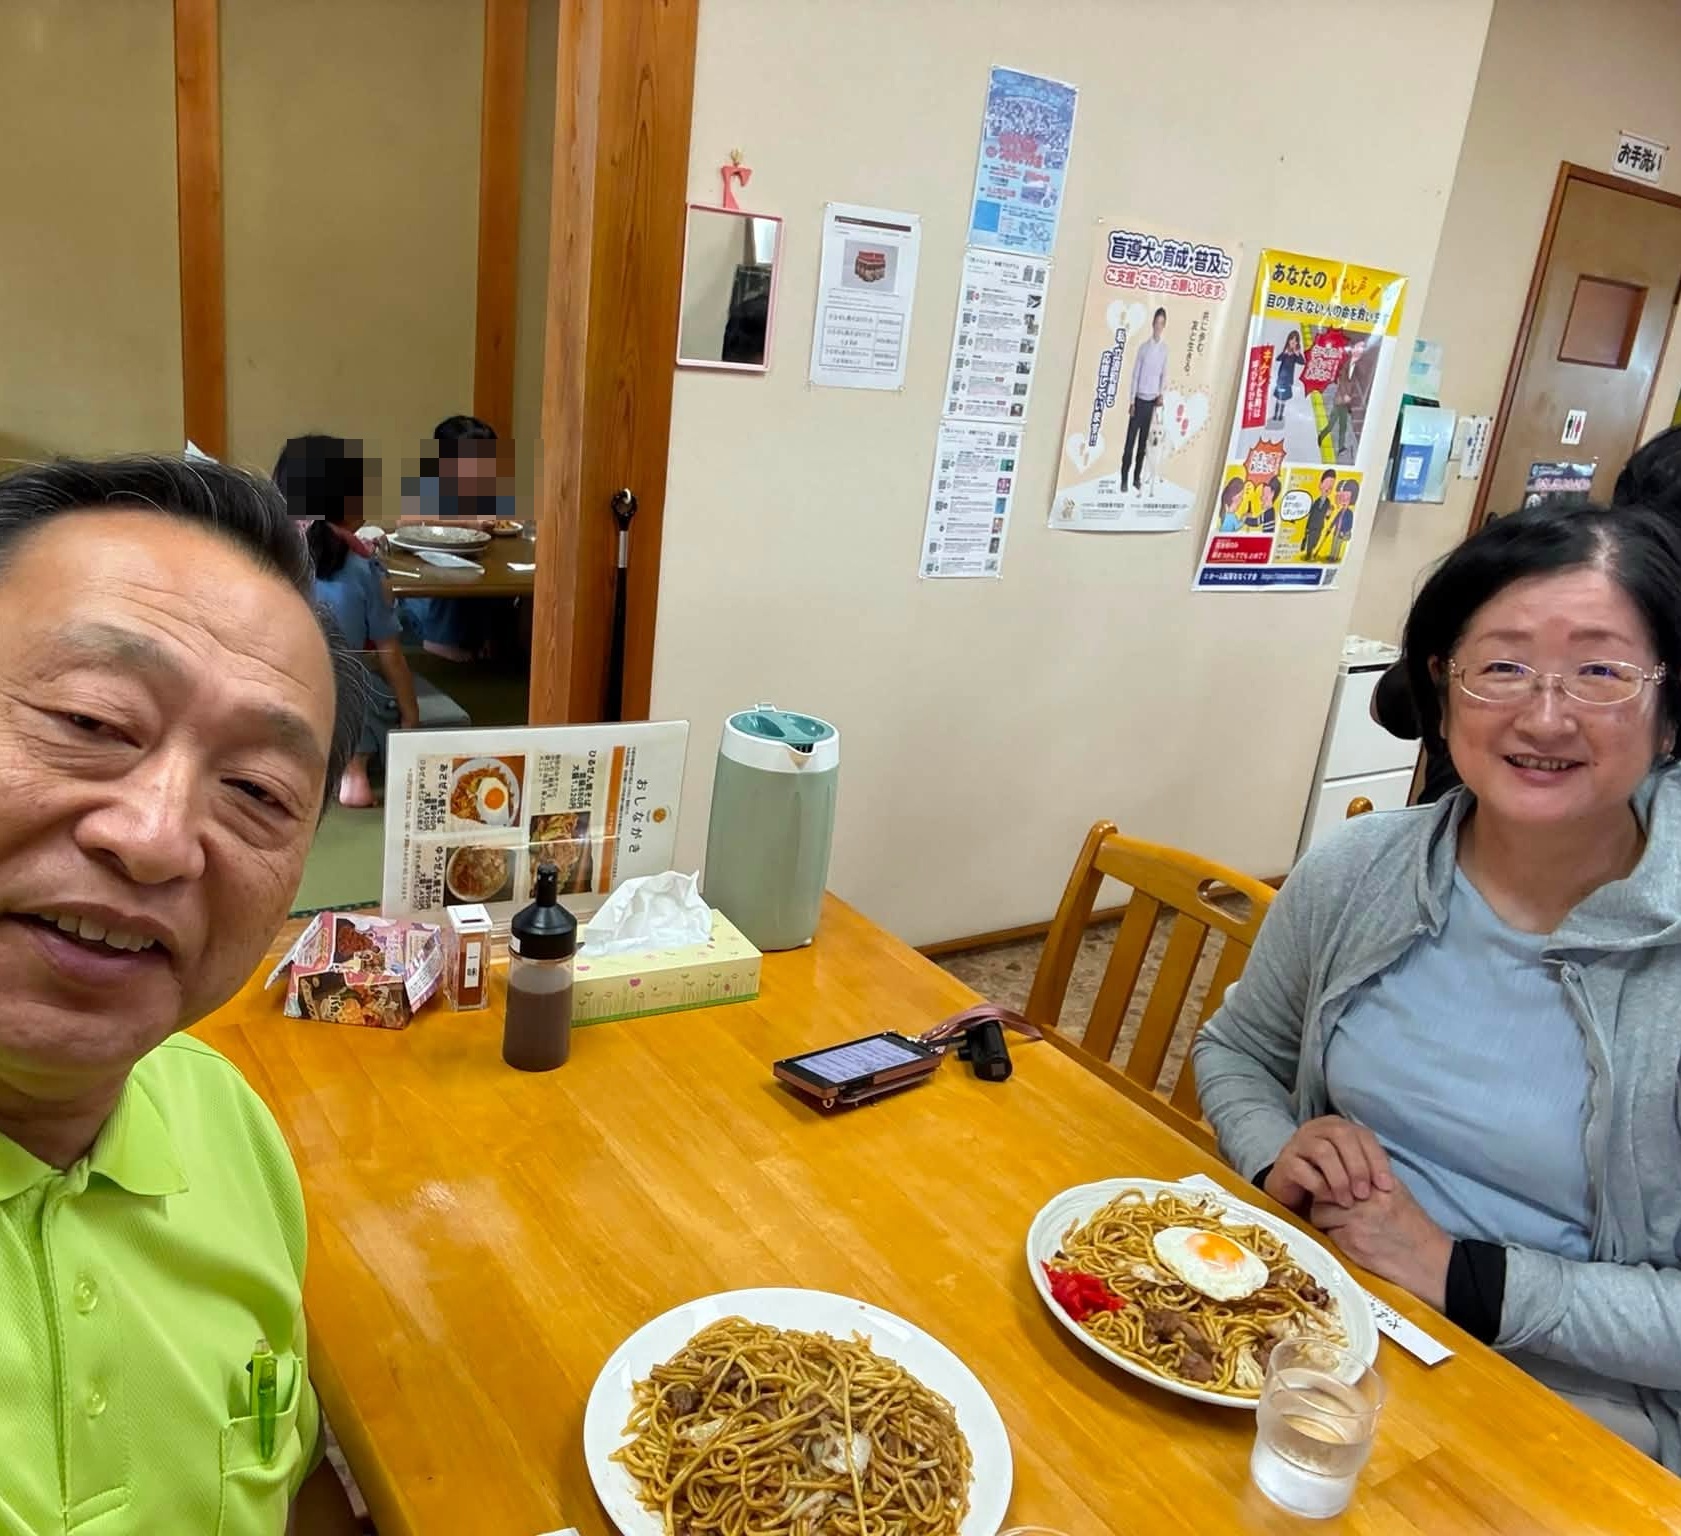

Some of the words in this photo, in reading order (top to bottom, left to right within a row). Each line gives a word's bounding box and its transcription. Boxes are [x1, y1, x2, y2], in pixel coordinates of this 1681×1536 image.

[1617, 143, 1662, 172] お手洗い
[1110, 234, 1231, 275] 盲導犬の育成・普及に
[1271, 262, 1328, 289] あなたの
[584, 749, 597, 807] ひるぜん焼そば
[628, 779, 649, 853] おしながき
